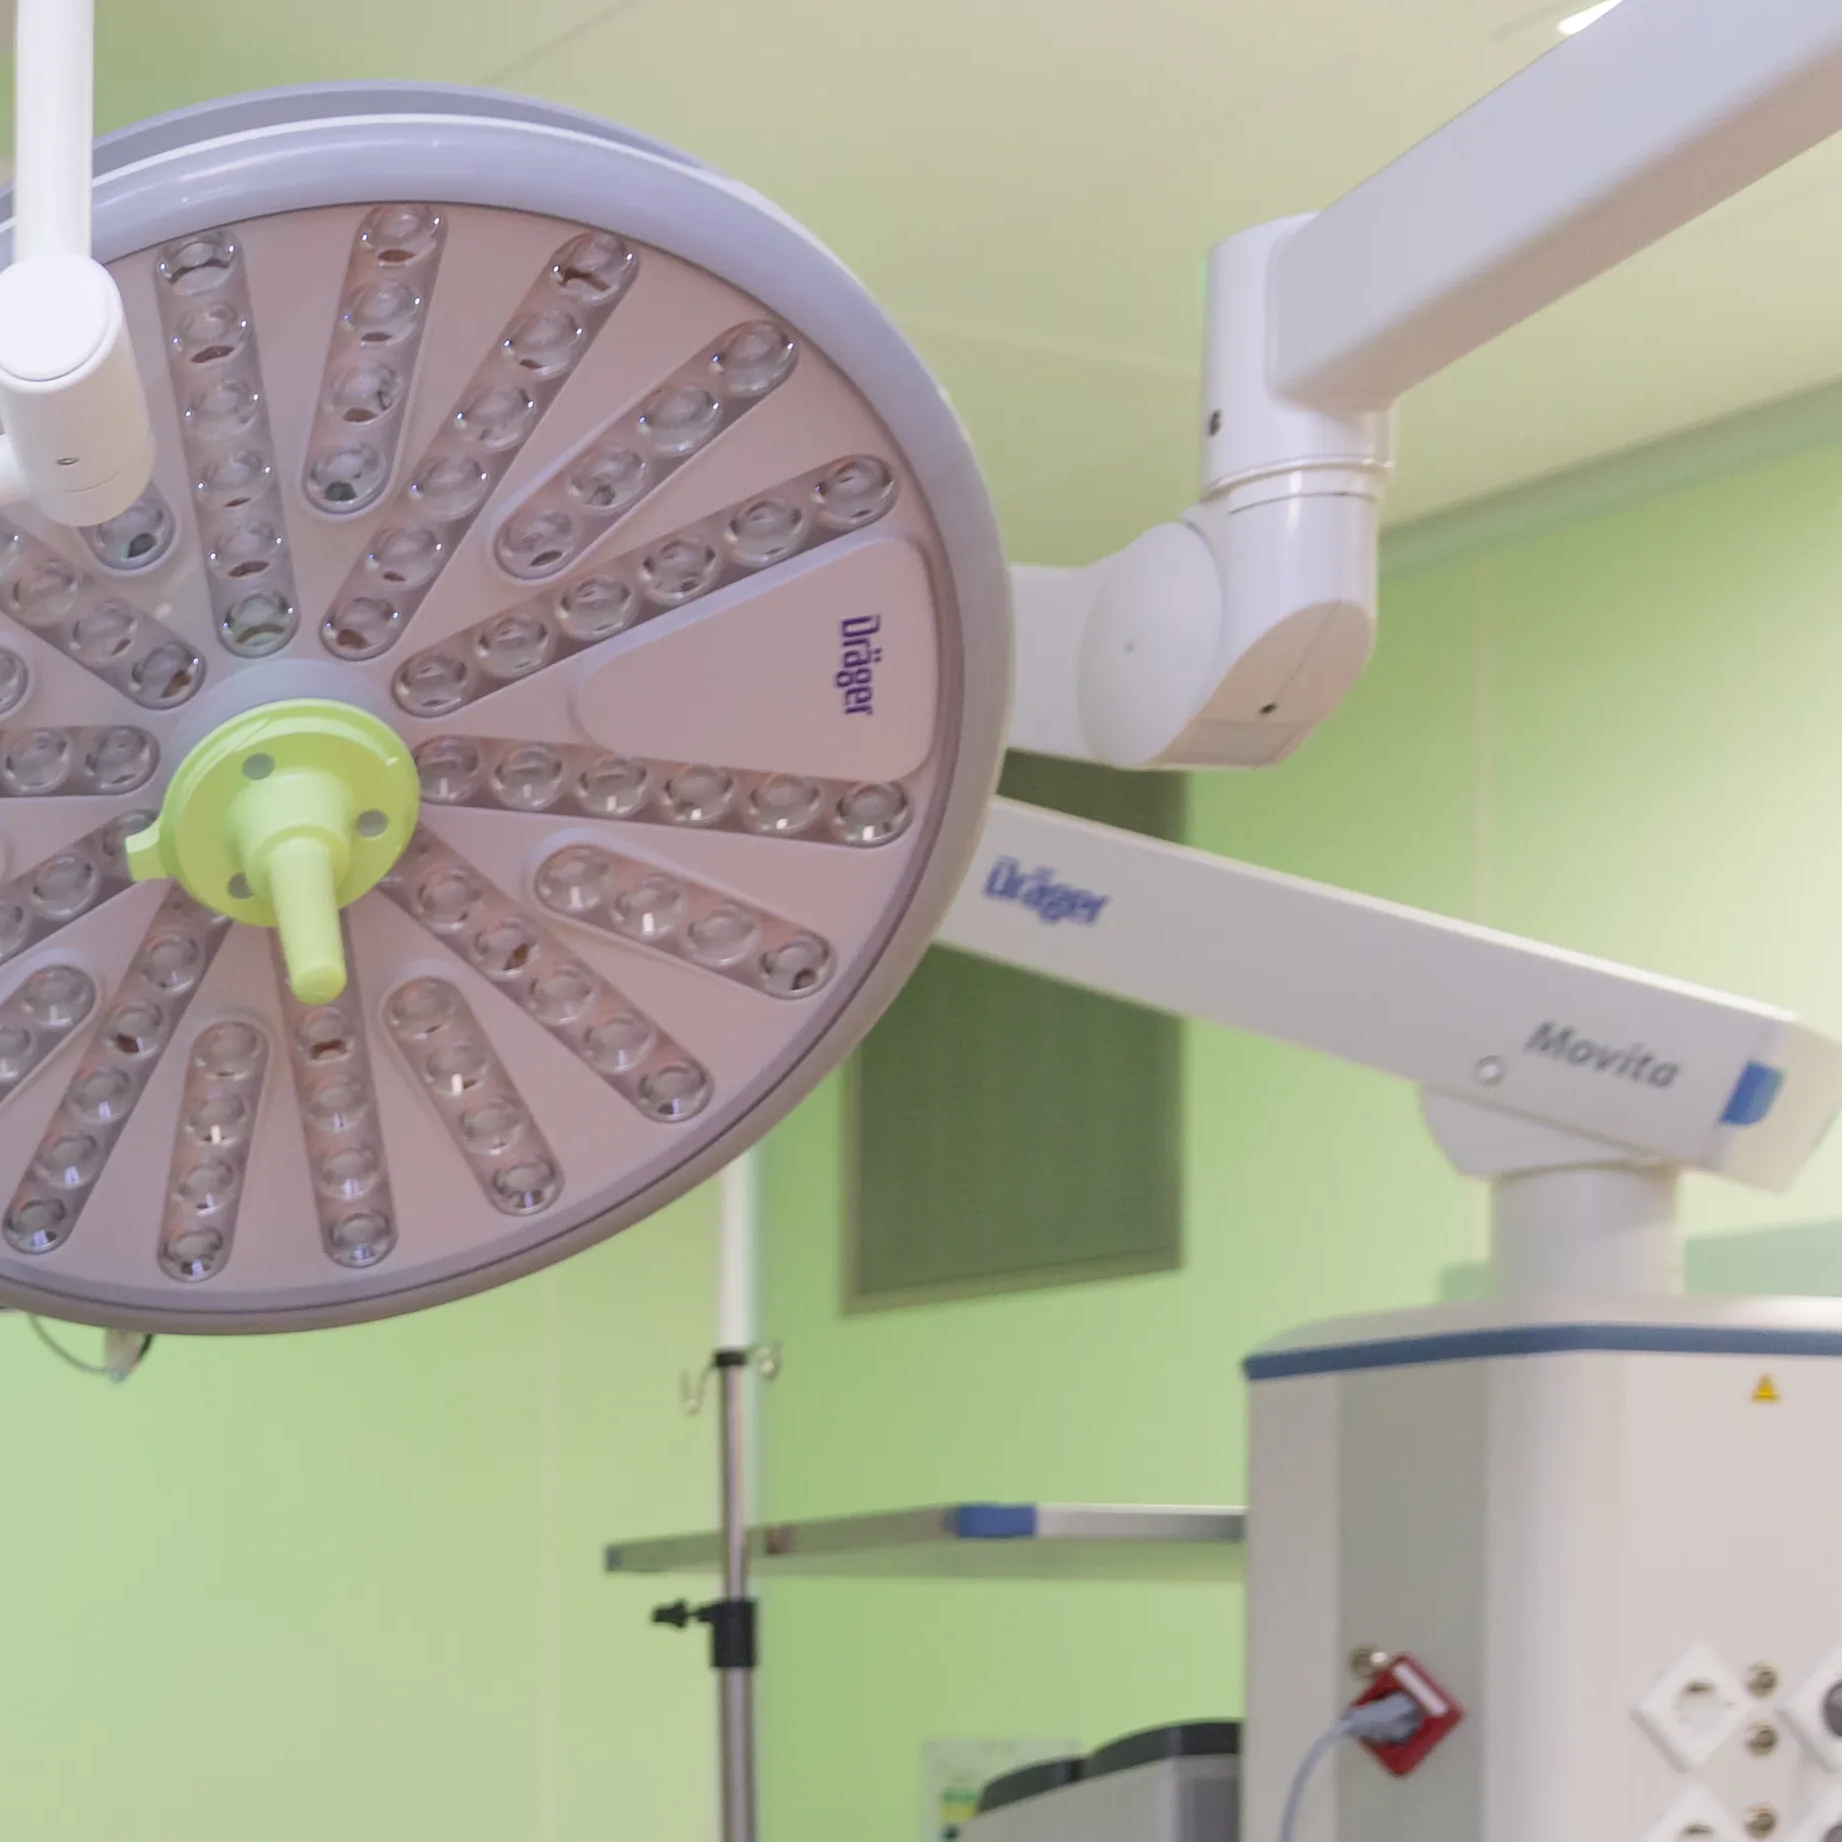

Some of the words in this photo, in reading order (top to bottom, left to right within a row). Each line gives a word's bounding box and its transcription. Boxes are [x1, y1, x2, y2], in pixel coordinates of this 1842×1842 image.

[834, 613, 882, 716] Dräger
[982, 854, 1111, 927] Dräger
[1524, 1019, 1683, 1091] Movita
